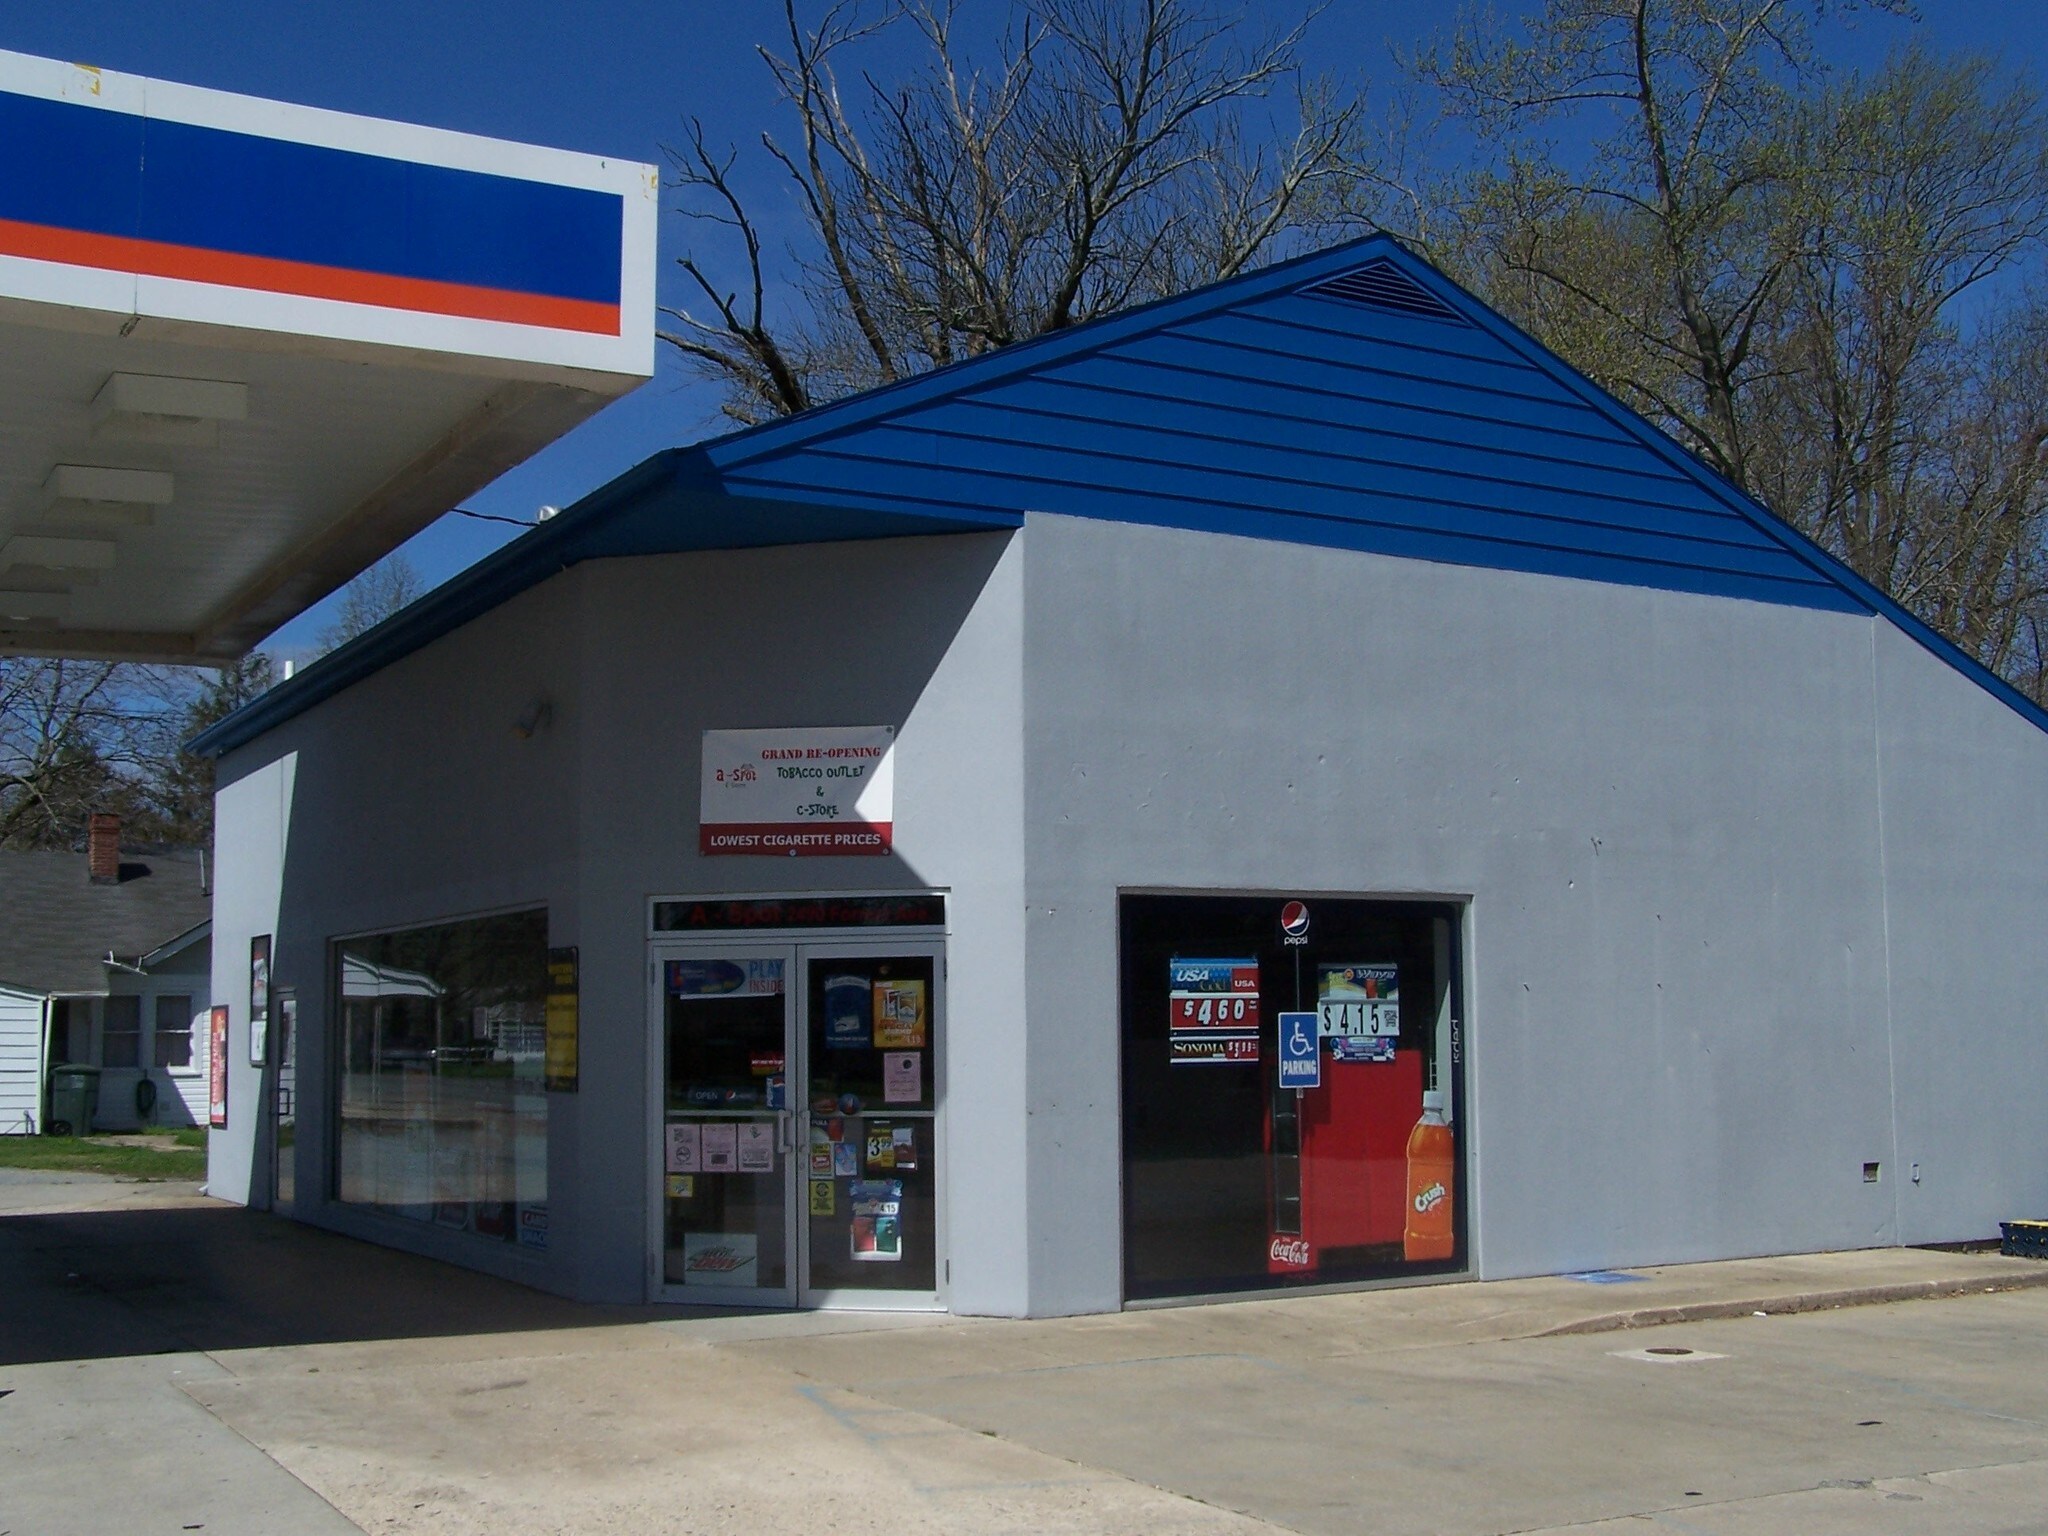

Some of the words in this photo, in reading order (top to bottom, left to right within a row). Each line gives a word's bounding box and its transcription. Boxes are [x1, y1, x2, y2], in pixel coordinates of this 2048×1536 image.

[761, 748, 803, 760] GRAND
[806, 747, 881, 759] RE-OPENING
[777, 766, 823, 779] TOBACCO
[826, 765, 865, 778] OUTLET
[816, 786, 824, 797] &
[710, 835, 761, 847] LOWEST
[765, 834, 832, 846] CIGARETTE
[835, 833, 881, 846] PRICES
[1284, 935, 1308, 946] pepsi
[749, 960, 784, 978] PLAY
[1176, 969, 1210, 982] USA
[749, 979, 784, 993] INSIDE
[1234, 980, 1255, 988] USA
[1173, 1042, 1225, 1053] SONOMA
[1282, 1060, 1317, 1076] PARKING
[695, 1091, 718, 1100] OPEN
